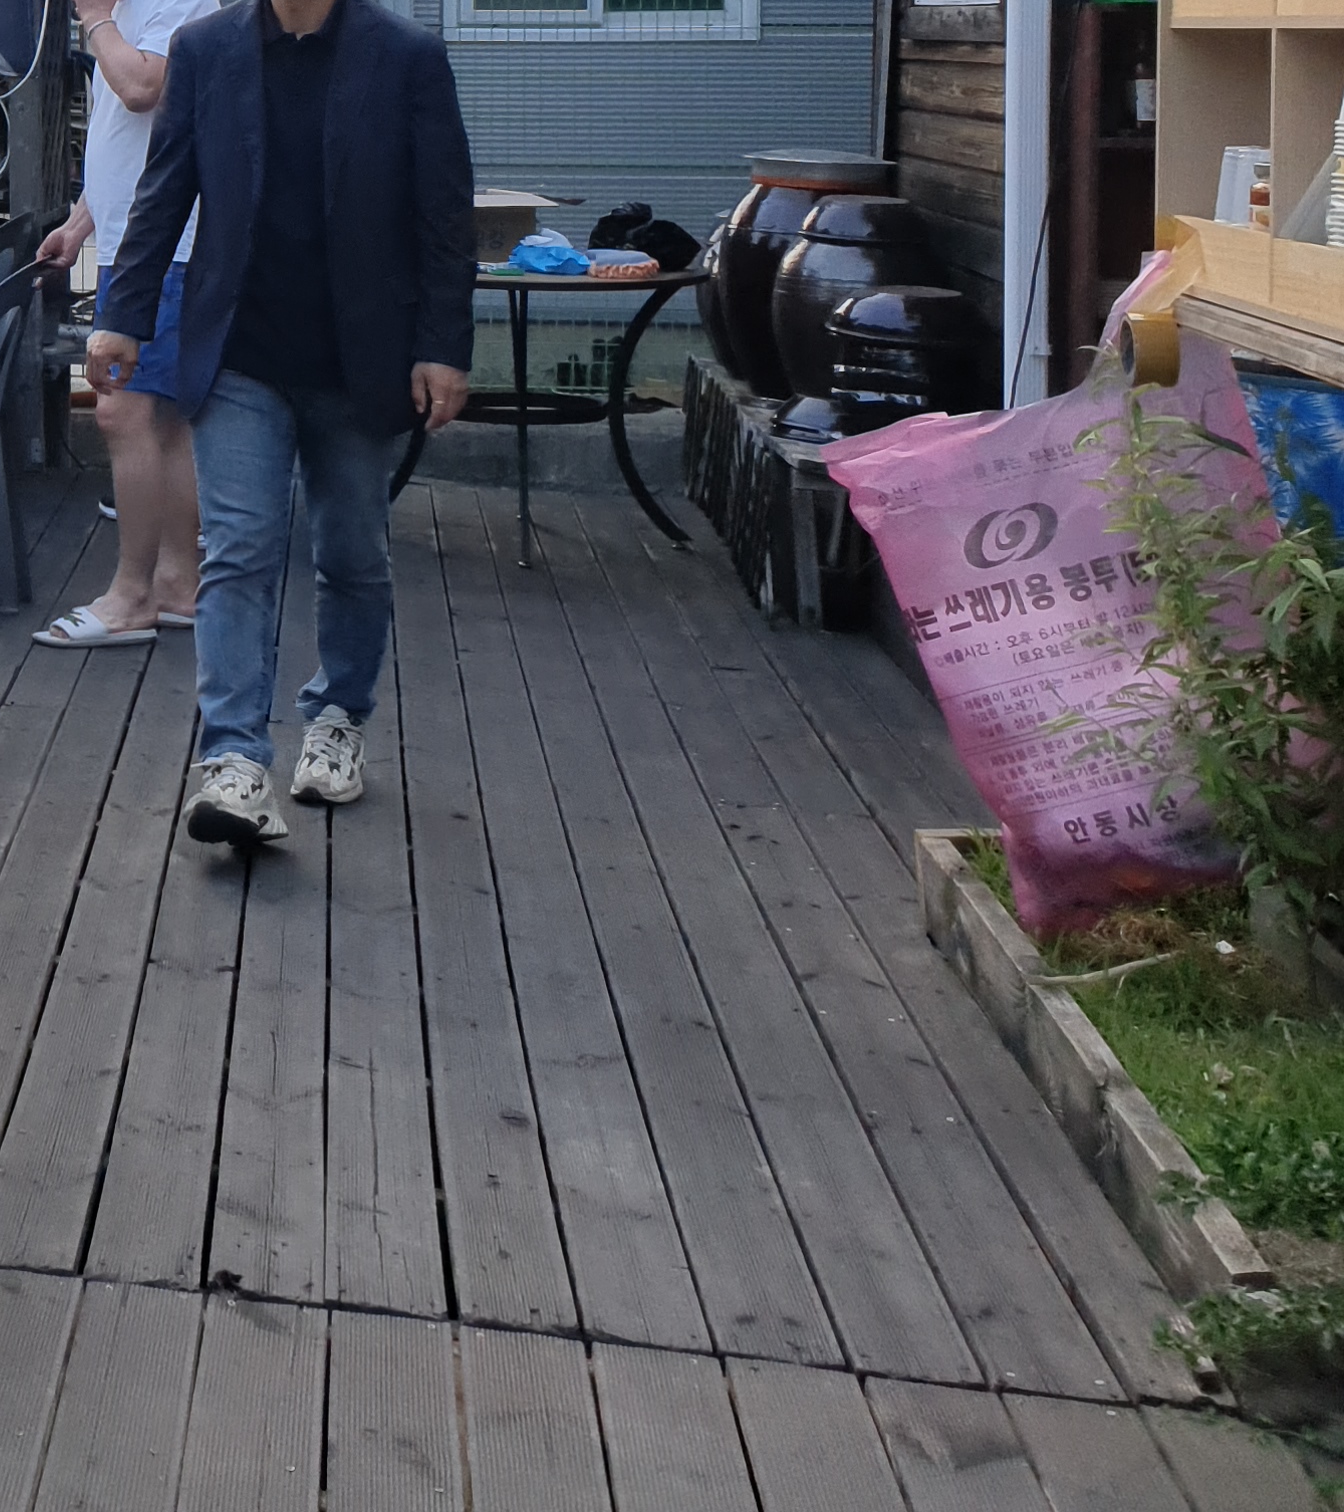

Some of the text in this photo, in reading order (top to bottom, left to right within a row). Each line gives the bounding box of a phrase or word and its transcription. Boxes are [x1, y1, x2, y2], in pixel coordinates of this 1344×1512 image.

[944, 572, 1056, 633] 쓰레기용
[1070, 664, 1107, 683] 쓰레기
[1004, 696, 1040, 716] 쓰레기
